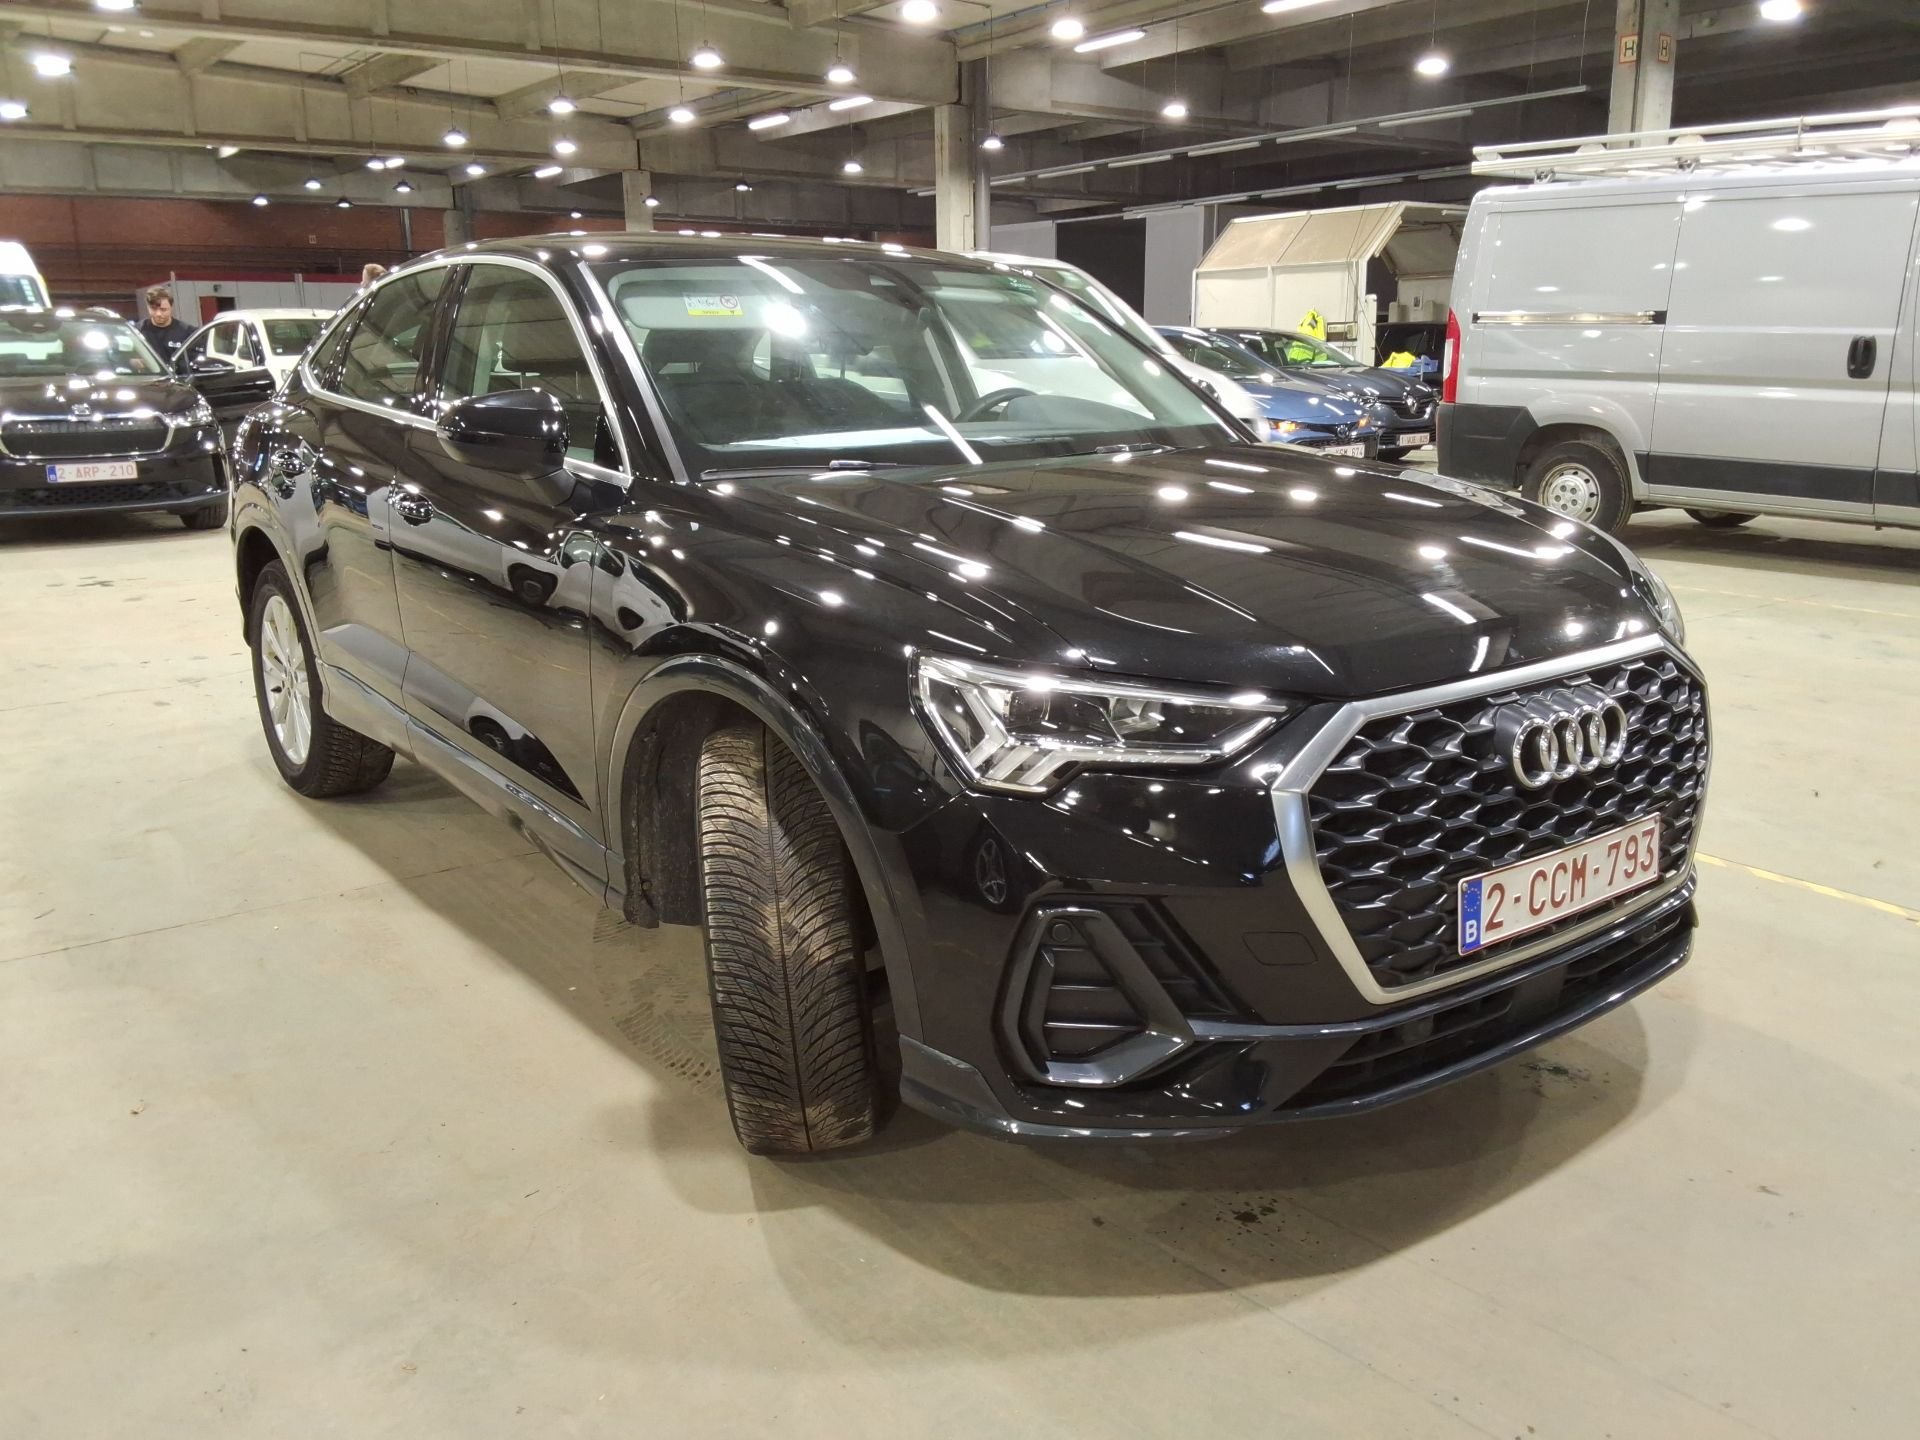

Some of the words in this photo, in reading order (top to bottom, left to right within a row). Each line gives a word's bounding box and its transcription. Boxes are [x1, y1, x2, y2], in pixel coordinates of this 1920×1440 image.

[1624, 40, 1634, 57] H
[58, 464, 134, 480] 2-ARP-210
[1484, 827, 1656, 932] 2-CCM-793
[1465, 920, 1478, 944] B
